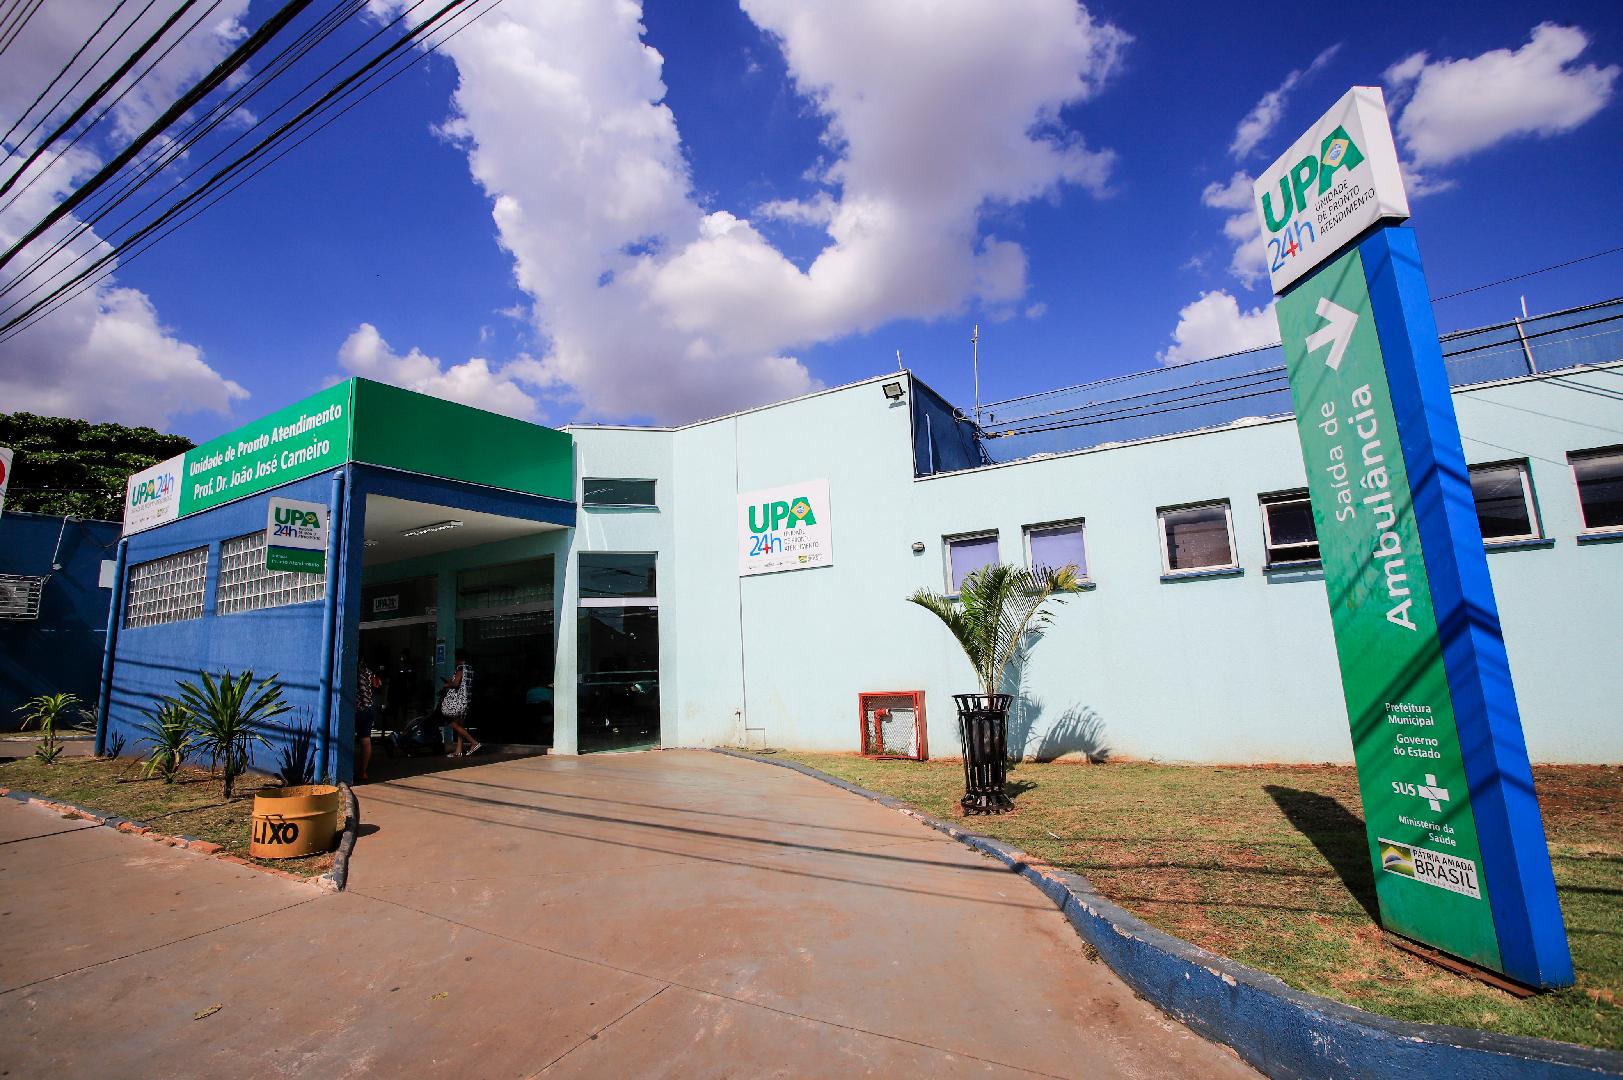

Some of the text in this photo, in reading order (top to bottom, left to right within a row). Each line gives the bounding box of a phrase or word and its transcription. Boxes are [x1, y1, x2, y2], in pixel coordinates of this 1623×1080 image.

[1261, 125, 1365, 233] UPA
[1315, 179, 1349, 212] UNIDADE
[1317, 185, 1361, 224] DE PRONTO
[1320, 187, 1375, 236] ATENDIMENTO
[1268, 219, 1316, 273] 24h
[1319, 400, 1339, 436] de
[189, 403, 342, 477] Unidade de Pronto Atendimento
[193, 439, 330, 500] Prof. Dr. João José Carneiro
[131, 479, 155, 507] UPA
[155, 472, 175, 499] 24h
[274, 506, 321, 529] UPA
[748, 496, 817, 534] UPA
[1347, 383, 1418, 632] Ambulância
[273, 523, 298, 538] 24h
[749, 532, 782, 557] 24h
[1385, 702, 1432, 714] Prefeitura
[1387, 714, 1435, 728] Municipal
[1393, 745, 1441, 759] do Estado
[1396, 733, 1439, 747] Governo
[1391, 781, 1417, 797] SUS
[253, 814, 299, 845] LIXO
[1398, 815, 1455, 835] Ministério da
[1428, 832, 1457, 847] Saúde
[1412, 849, 1474, 873] PÁTRIA AMADA
[1414, 859, 1477, 890] BRASIL
